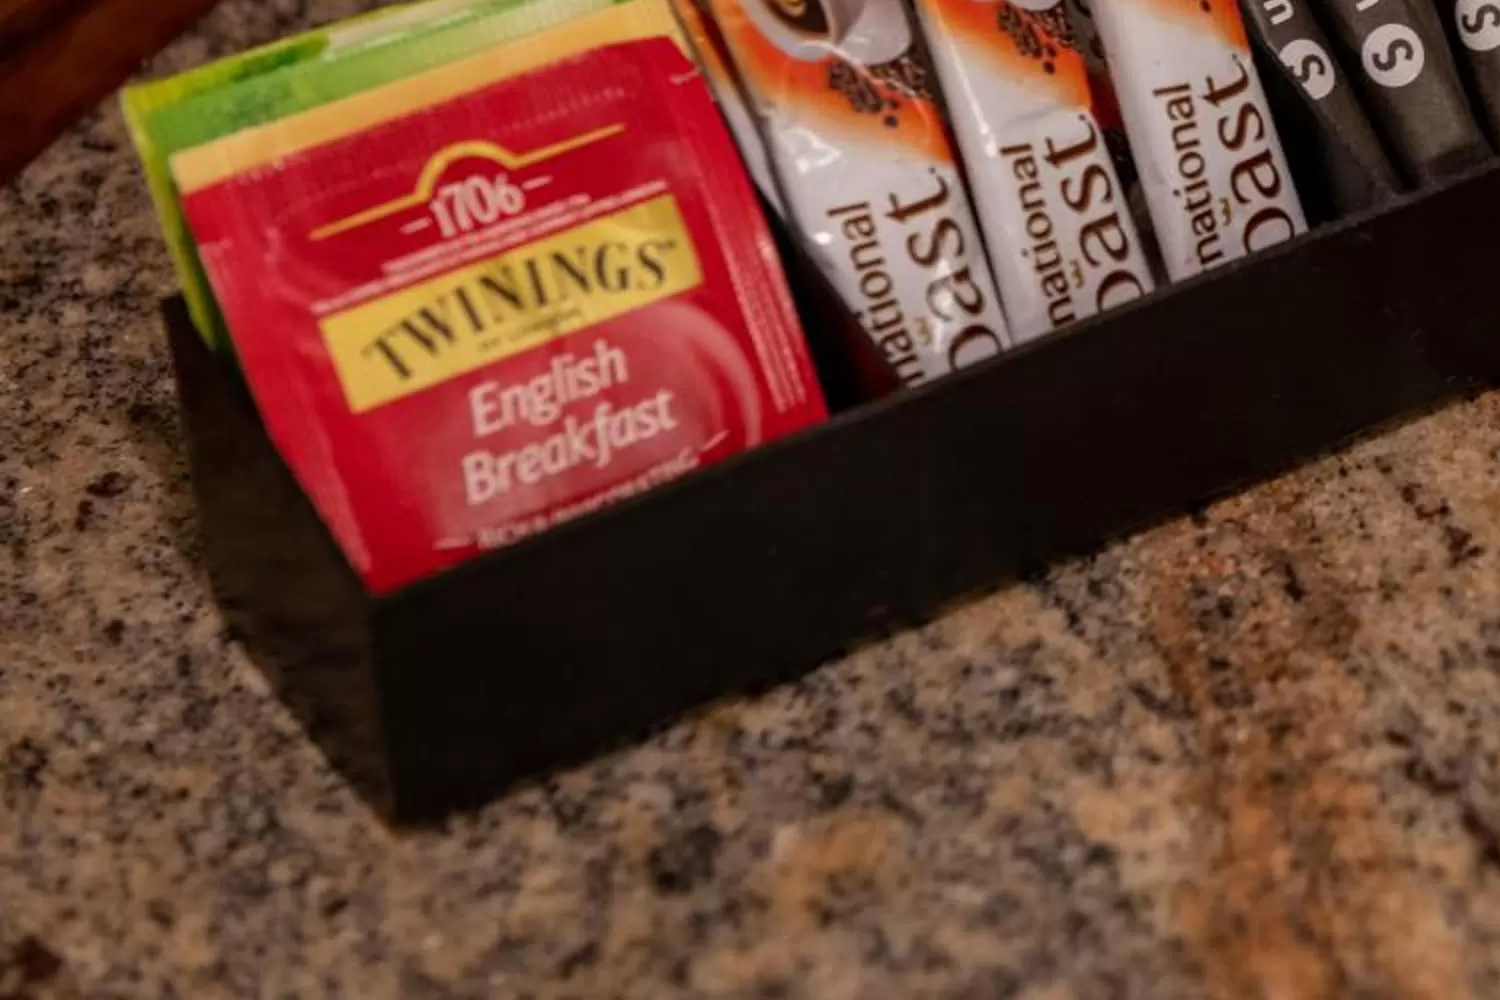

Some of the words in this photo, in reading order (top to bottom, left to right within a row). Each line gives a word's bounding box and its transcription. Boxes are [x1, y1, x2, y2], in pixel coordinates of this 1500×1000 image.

[430, 175, 525, 240] 1706
[469, 337, 628, 438] English
[462, 387, 675, 506] Breakfast
